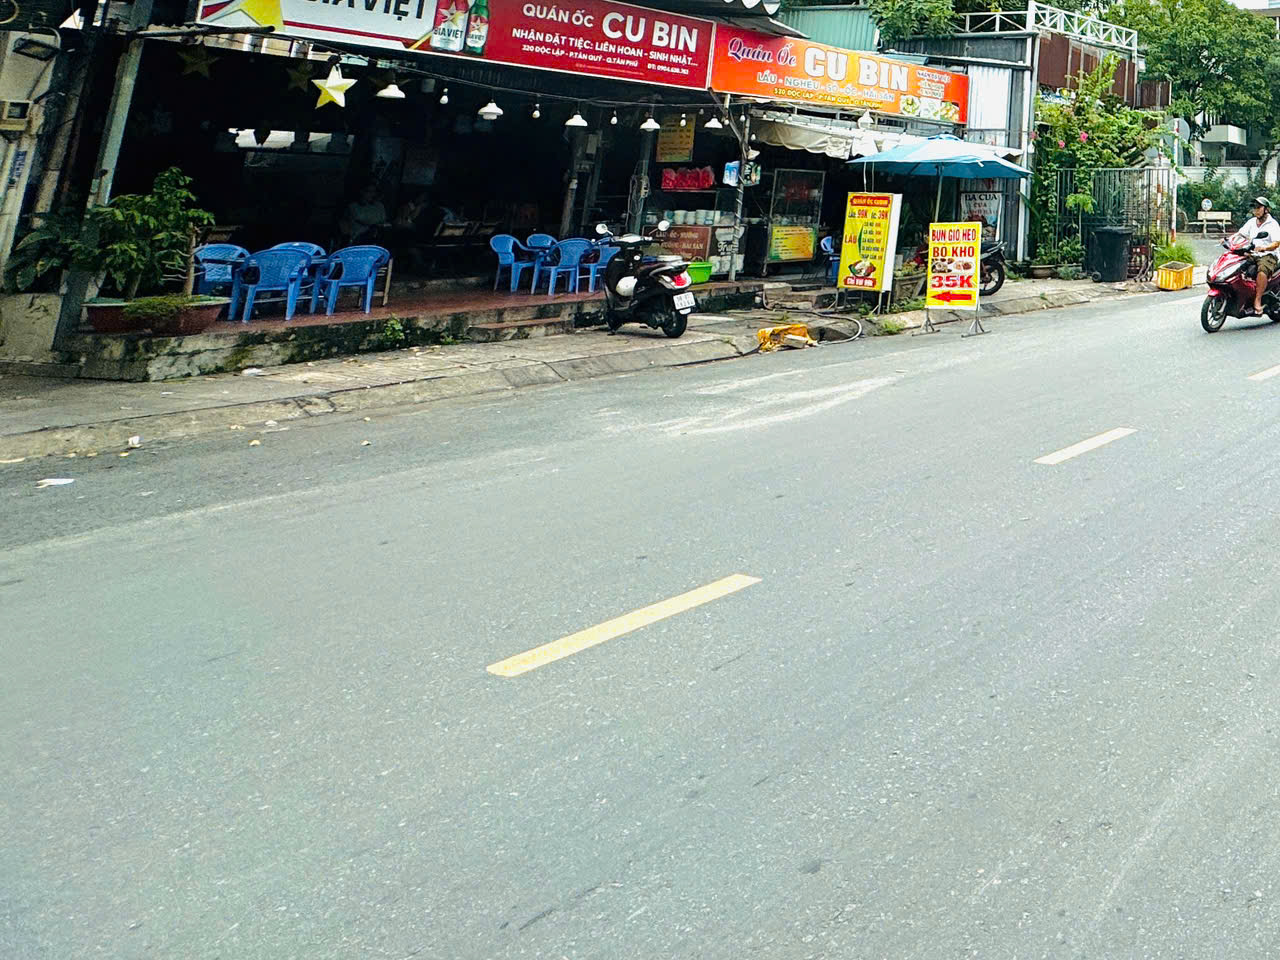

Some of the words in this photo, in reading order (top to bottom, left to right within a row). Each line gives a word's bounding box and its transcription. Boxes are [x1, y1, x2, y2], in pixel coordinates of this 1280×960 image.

[522, 3, 570, 23] QUÁN
[571, 9, 594, 28] ỐC
[602, 11, 646, 43] CU
[651, 20, 699, 53] BIN
[512, 28, 544, 42] NHẬN
[545, 32, 567, 46] ĐẶT
[568, 37, 594, 50] TIỆC:
[595, 42, 616, 53] LIÊN
[617, 45, 643, 57] HOAN
[649, 50, 669, 61] SINH
[728, 37, 773, 62] Quán
[776, 43, 797, 66] Ốc
[803, 47, 848, 82] CU
[858, 56, 909, 92] BIN
[962, 229, 977, 241] HEO
[951, 246, 975, 257] KHO
[931, 275, 973, 289] 35K
